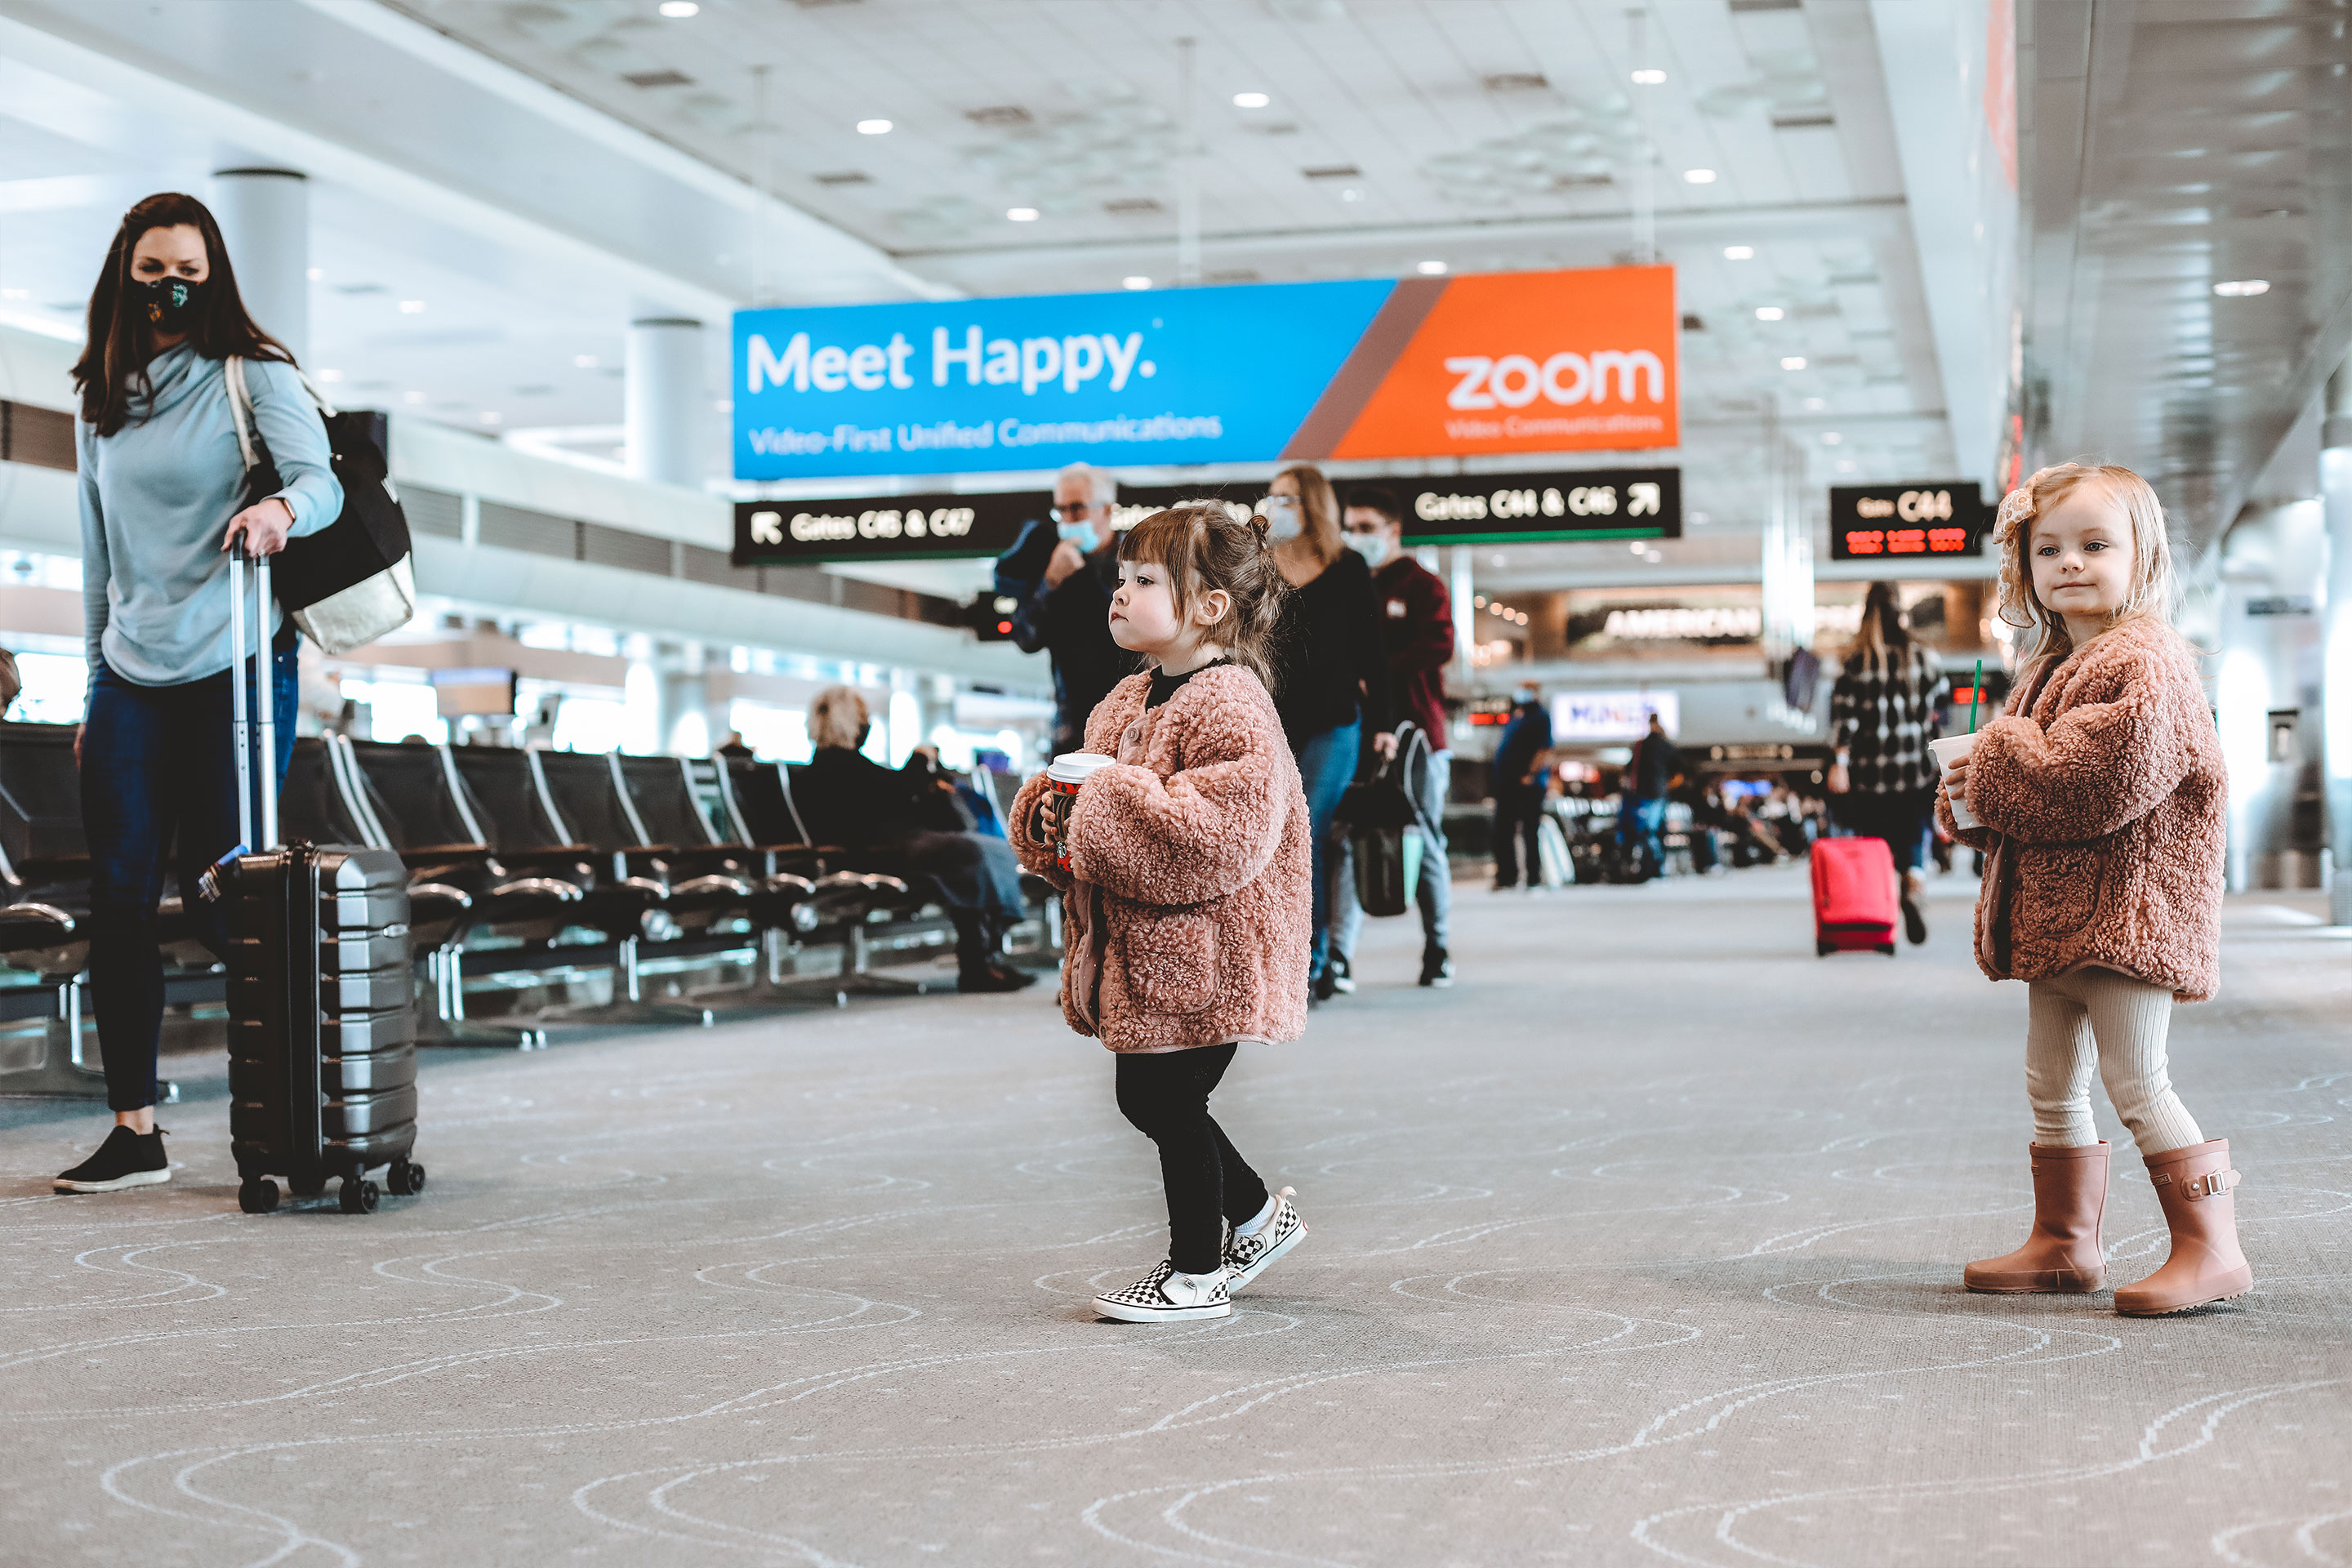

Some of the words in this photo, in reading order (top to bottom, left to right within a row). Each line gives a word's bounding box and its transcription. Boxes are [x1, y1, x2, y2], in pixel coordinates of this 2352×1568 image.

[747, 332, 915, 394] Meet
[933, 324, 1156, 395] Happy.
[1445, 350, 1664, 409] zoom
[748, 424, 892, 455] Video-First
[897, 420, 994, 451] Unified
[998, 412, 1223, 447] Communications
[1444, 417, 1503, 440] Video
[1503, 414, 1664, 439] Communications
[1414, 492, 1488, 521] Gates
[1541, 488, 1565, 517] &
[1897, 489, 1953, 523] C44
[790, 513, 857, 541] Gates
[904, 509, 927, 537] &
[1605, 608, 1762, 639] AMERICAN
